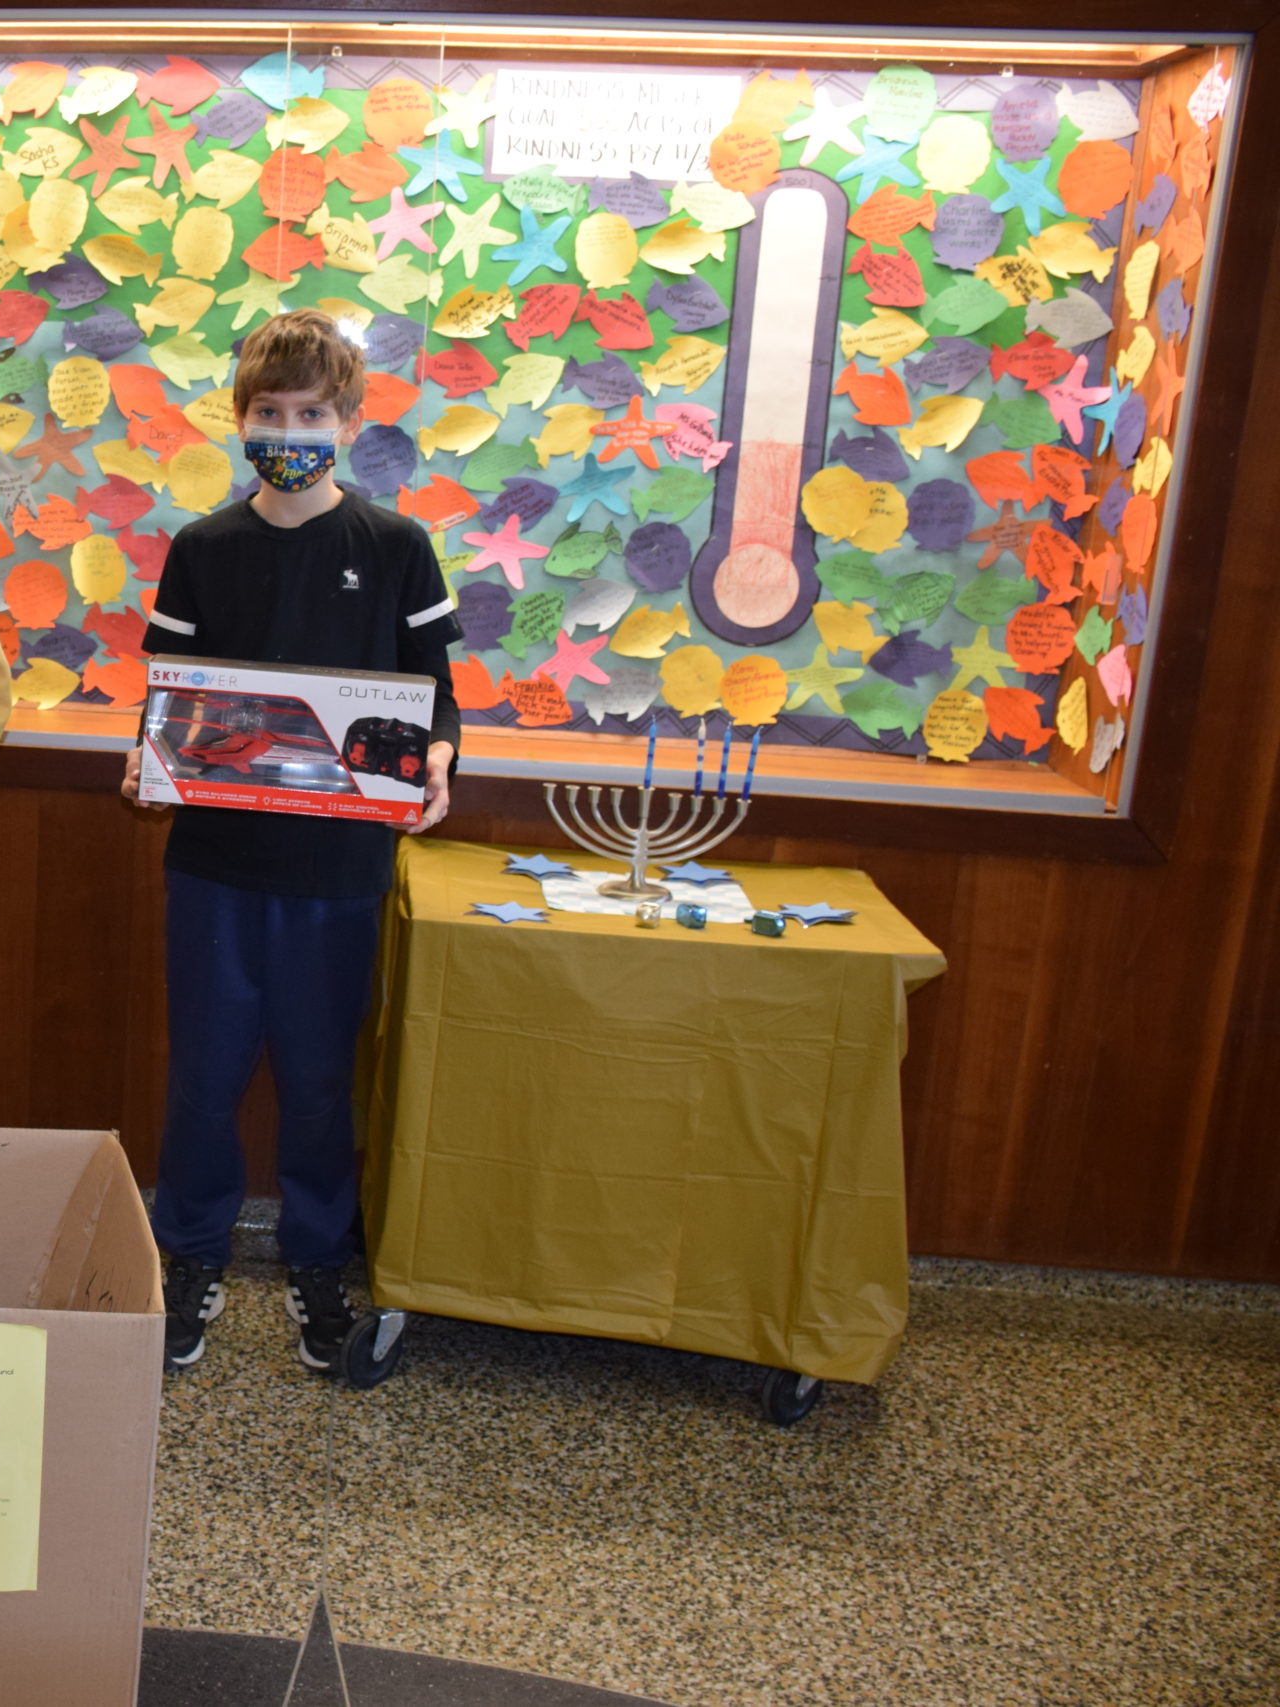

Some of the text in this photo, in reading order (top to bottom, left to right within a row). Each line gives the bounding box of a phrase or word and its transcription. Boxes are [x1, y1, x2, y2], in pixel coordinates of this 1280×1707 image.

[20, 144, 56, 166] Sasha
[42, 155, 60, 171] KS
[628, 143, 663, 166] BY
[324, 221, 369, 254] Brianna
[334, 242, 354, 261] KS
[338, 685, 428, 704] OUTLAW
[513, 681, 556, 693] Frankie
